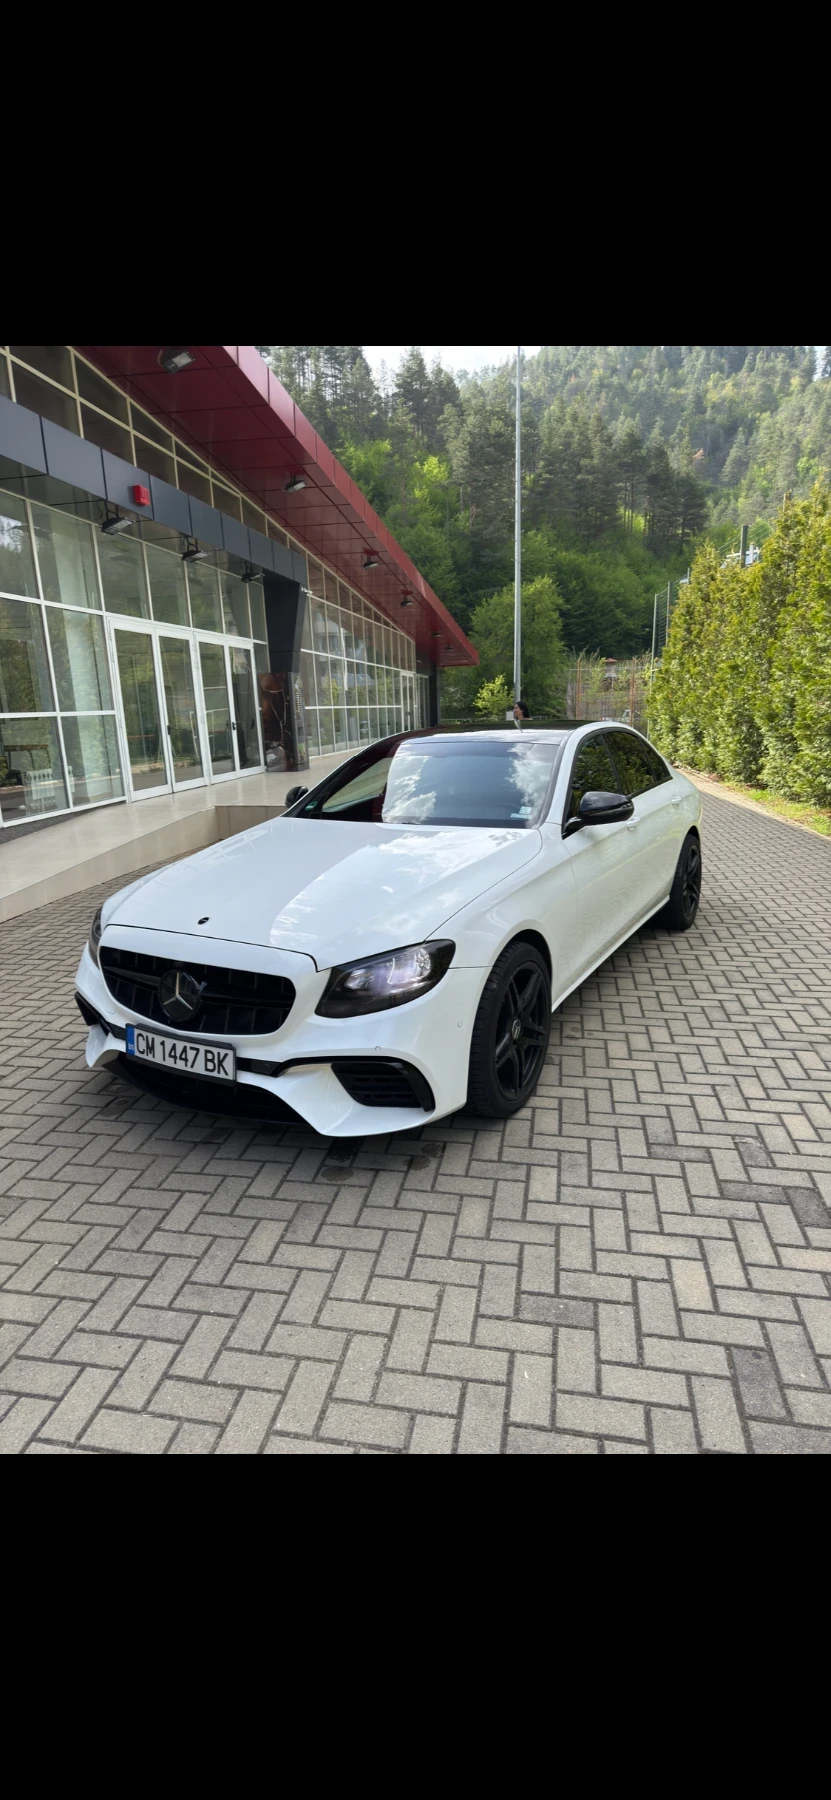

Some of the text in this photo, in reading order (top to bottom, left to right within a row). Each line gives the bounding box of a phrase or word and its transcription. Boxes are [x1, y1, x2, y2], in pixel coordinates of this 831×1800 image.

[136, 1032, 229, 1076] CM 1447 BK
